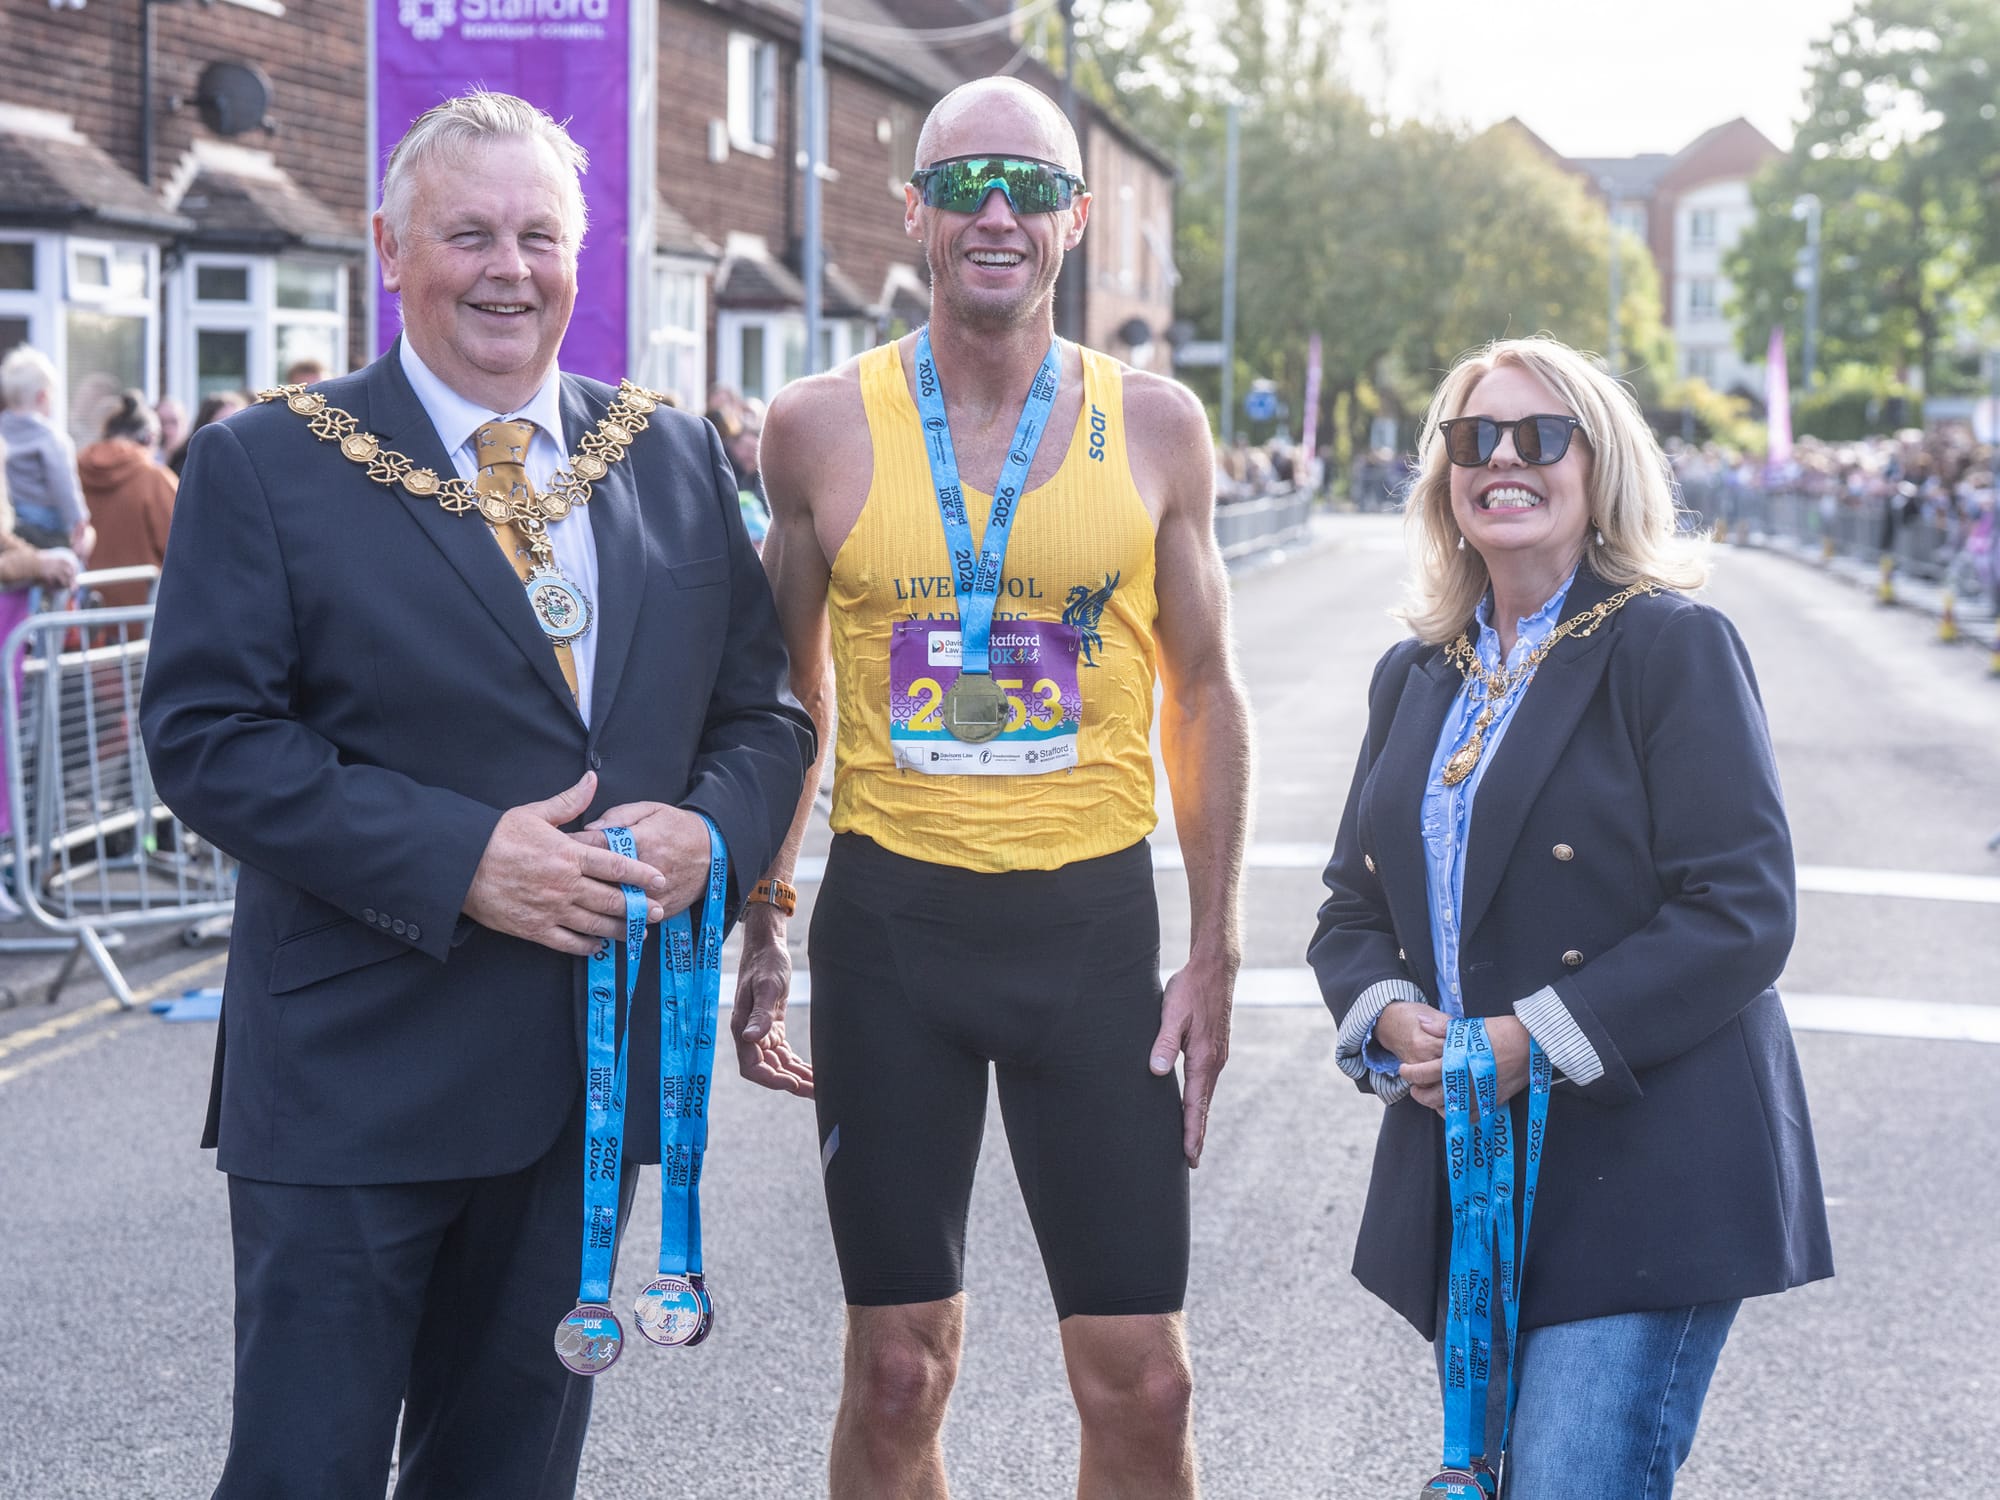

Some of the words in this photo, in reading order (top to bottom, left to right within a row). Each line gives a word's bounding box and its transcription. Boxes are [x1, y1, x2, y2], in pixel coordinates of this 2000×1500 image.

[920, 359, 937, 397] 2026
[1032, 364, 1050, 399] stafford
[1040, 385, 1055, 403] 10K
[1089, 404, 1107, 463] soar
[939, 487, 952, 514] 10K
[951, 485, 967, 526] stafford
[992, 486, 1016, 528] 2026
[975, 550, 990, 593] stafford
[982, 569, 998, 594] 10K
[893, 576, 1043, 600] LIVEOL
[988, 634, 1040, 647] tafford
[990, 648, 1016, 665] 0K
[907, 678, 1064, 732] 253
[1040, 744, 1069, 758] Stafford
[629, 918, 638, 943] 10K
[671, 930, 683, 974] stafford
[1532, 1053, 1543, 1076] 10K
[590, 1067, 602, 1091] 10K
[663, 1075, 675, 1100] 10K
[1445, 1070, 1458, 1094] 10K
[1458, 1068, 1468, 1111] stafford
[1476, 1076, 1488, 1099] 10K
[1530, 1119, 1543, 1163] 2026
[601, 1136, 618, 1182] 2026
[1451, 1136, 1464, 1180] 2026
[678, 1163, 689, 1188] 10K
[590, 1205, 602, 1249] stafford
[599, 1226, 613, 1249] 10K
[651, 1281, 692, 1292] stafford
[662, 1292, 680, 1302] 10K
[1475, 1277, 1490, 1320] 2026
[572, 1310, 614, 1319] stafford
[583, 1319, 602, 1329] 10K
[1449, 1345, 1457, 1389] stafford
[1456, 1365, 1465, 1389] 10K
[1475, 1358, 1488, 1382] 10K
[1447, 1484, 1465, 1495] 10K
